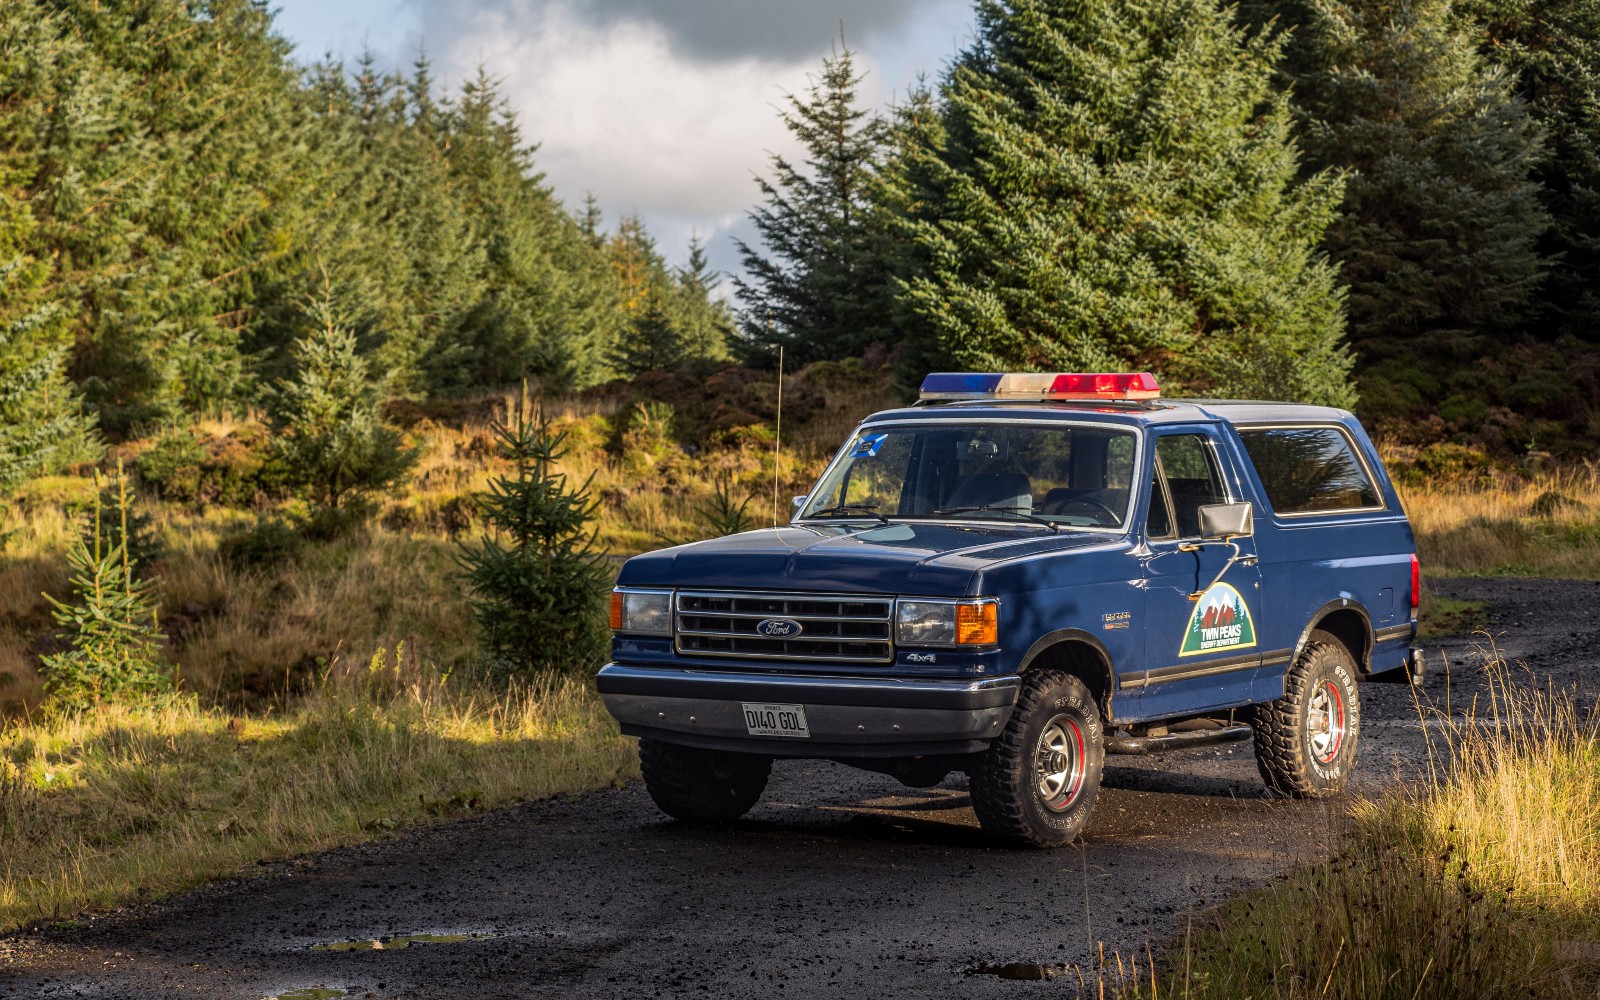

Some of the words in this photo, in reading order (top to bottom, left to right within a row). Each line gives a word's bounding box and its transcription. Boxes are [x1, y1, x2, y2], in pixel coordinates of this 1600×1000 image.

[765, 622, 790, 635] Ford
[1201, 627, 1219, 641] TWIN
[1219, 624, 1242, 638] PEAKS
[1200, 640, 1217, 649] SHERIFF
[1216, 637, 1240, 647] DEPARTMENT
[906, 653, 936, 663] 4x4
[779, 711, 805, 731] GDL
